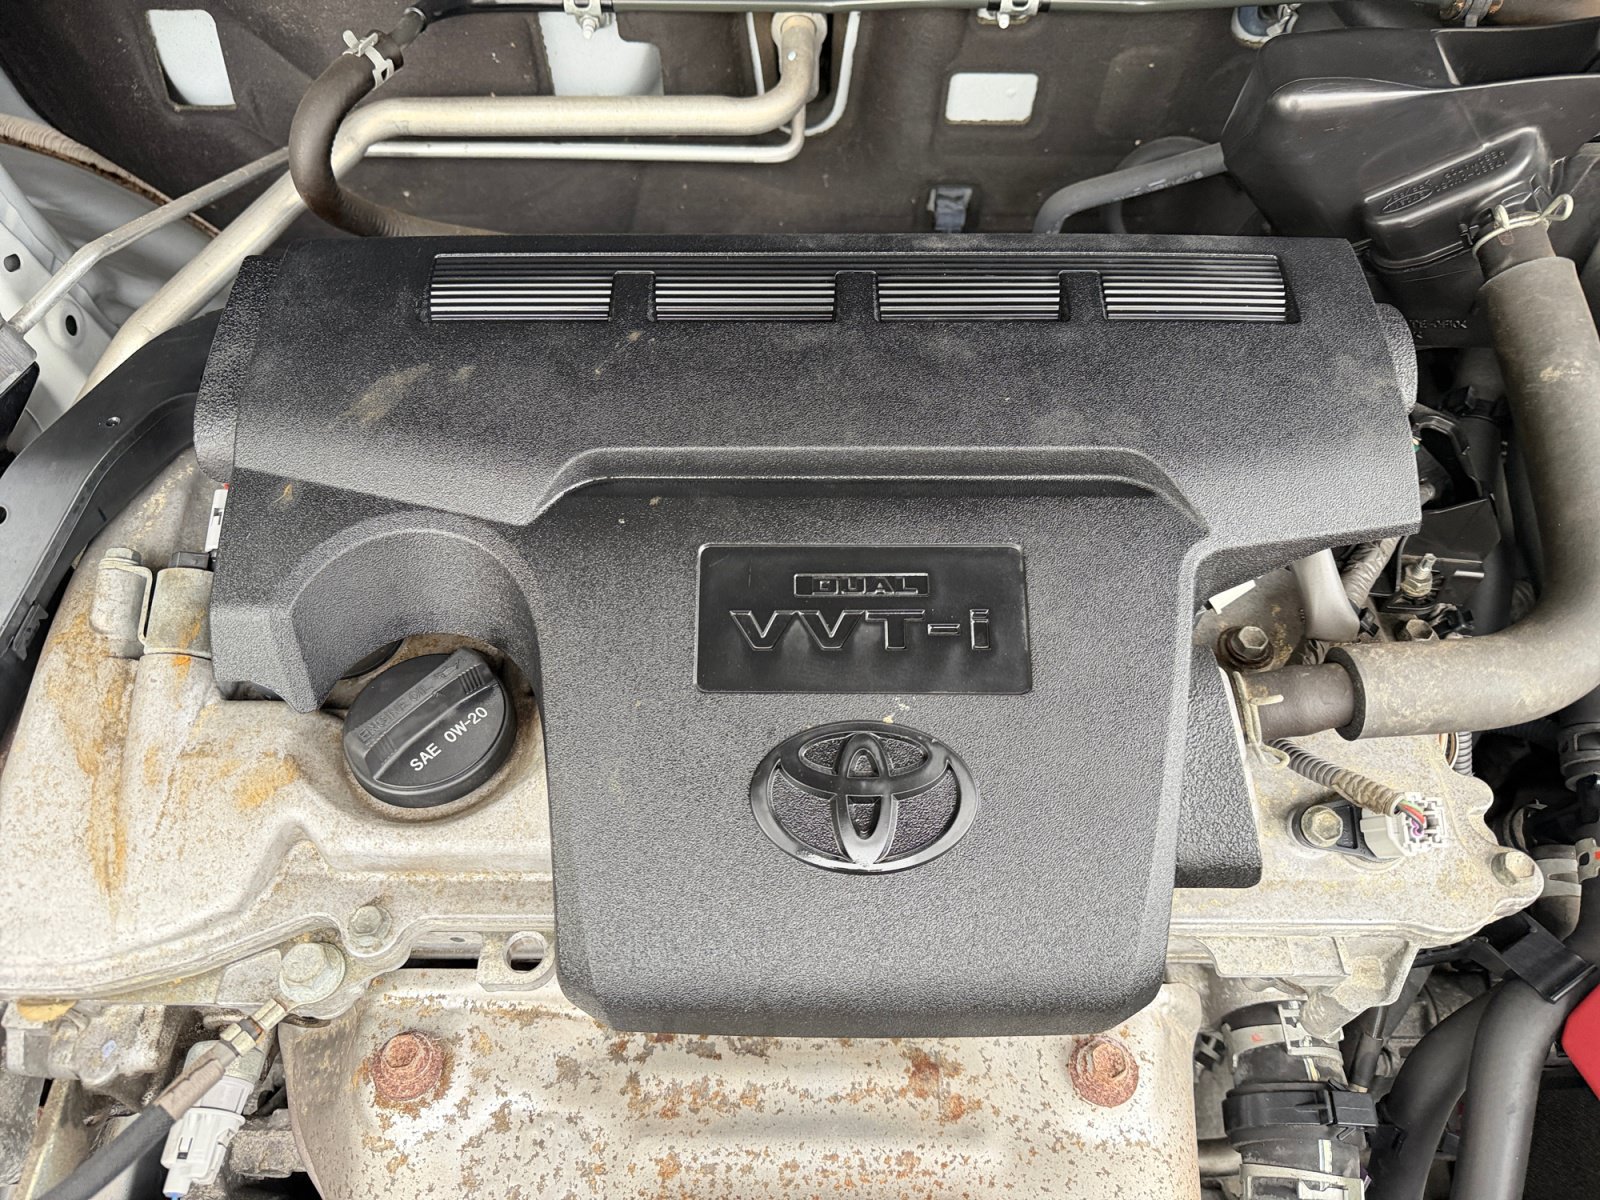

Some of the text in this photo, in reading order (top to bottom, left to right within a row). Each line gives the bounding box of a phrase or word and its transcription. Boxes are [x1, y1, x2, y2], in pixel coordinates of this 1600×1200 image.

[811, 575, 919, 595] DUAL
[730, 609, 991, 650] VVT-i
[358, 680, 434, 744] ENGINE OIL
[410, 706, 488, 771] SAE 0W-20
